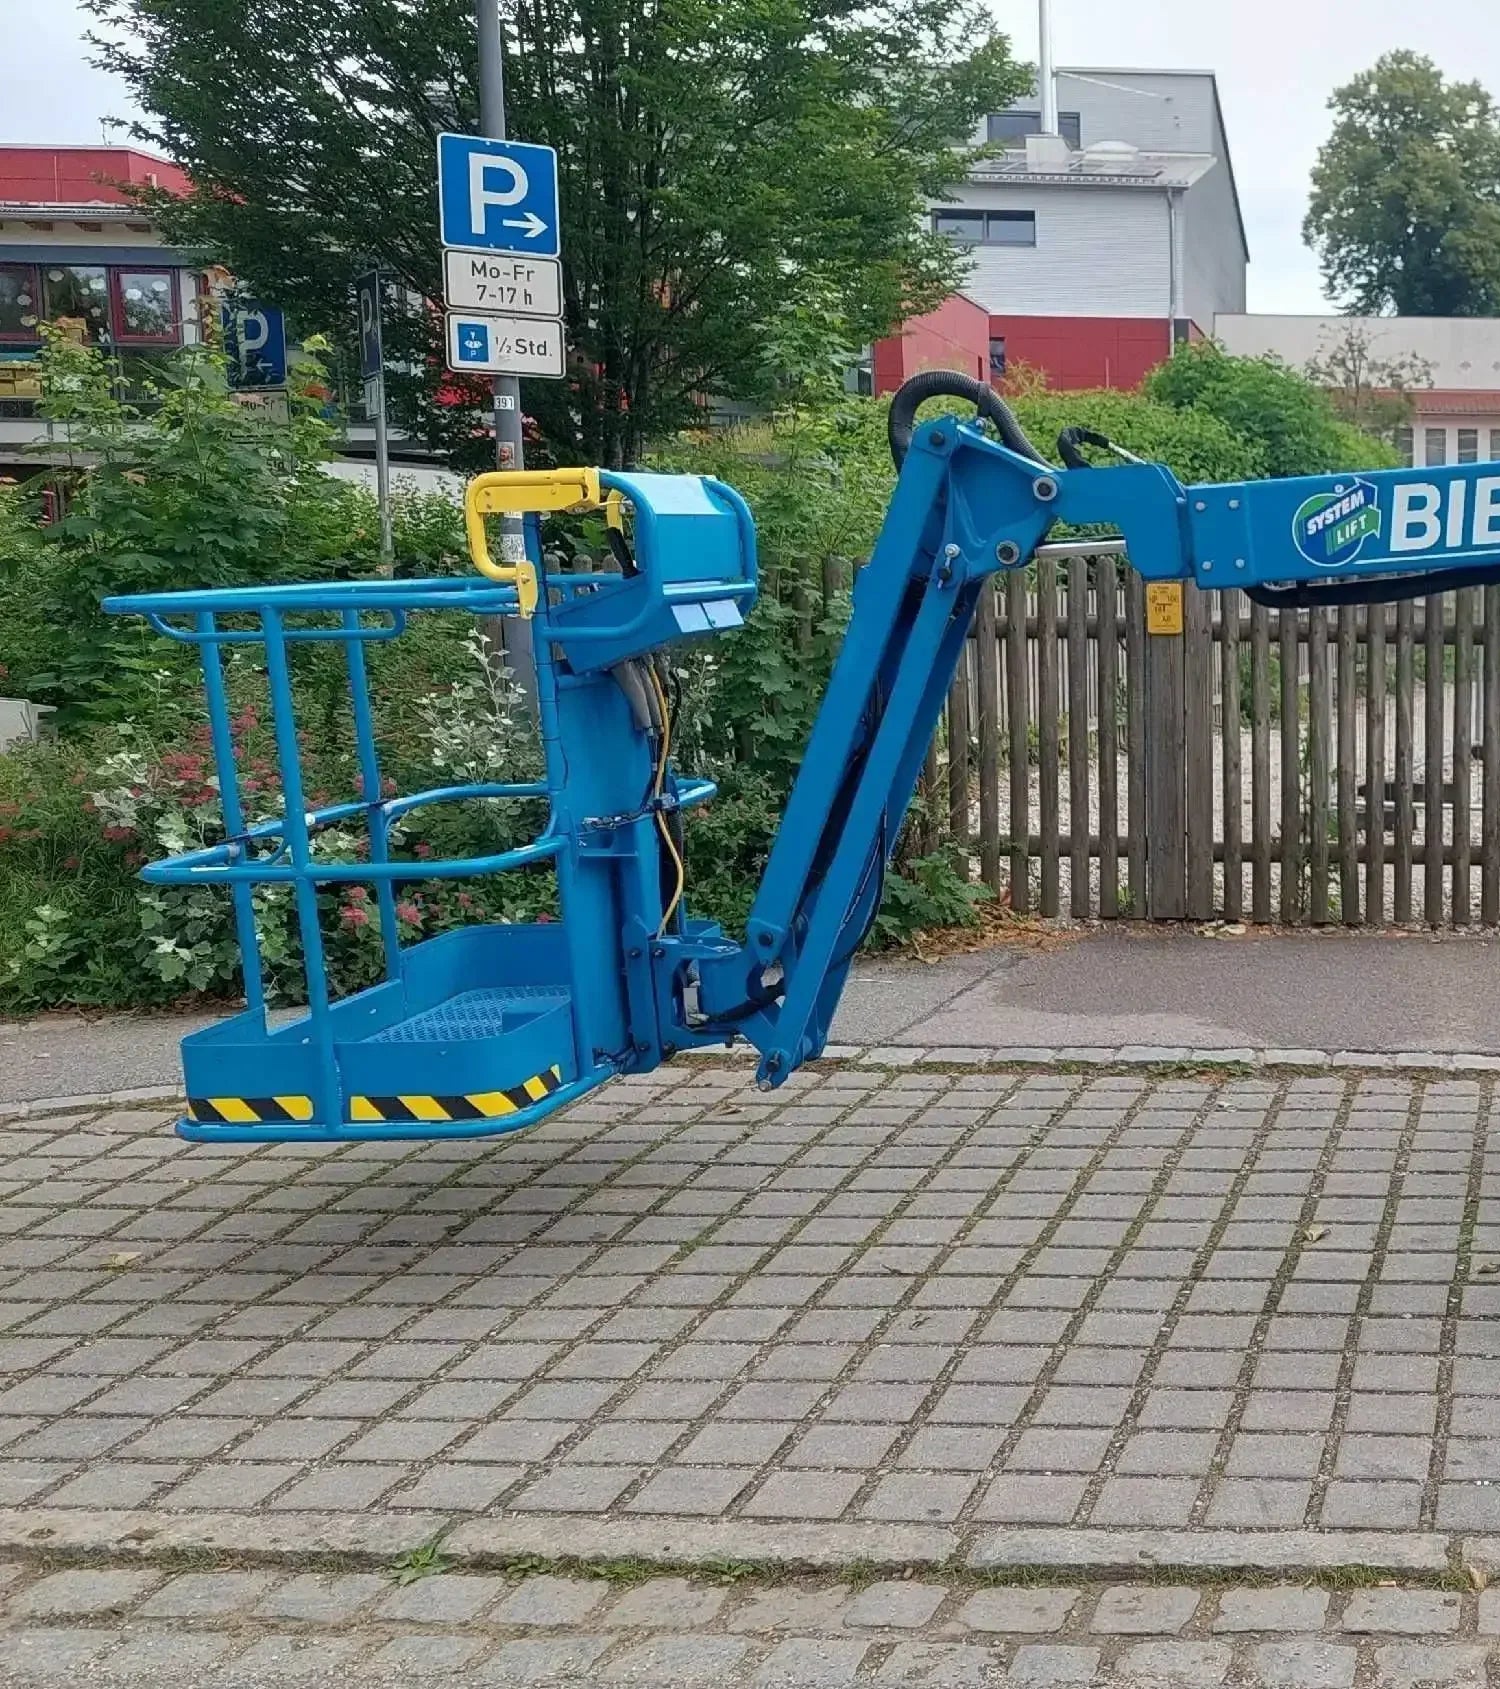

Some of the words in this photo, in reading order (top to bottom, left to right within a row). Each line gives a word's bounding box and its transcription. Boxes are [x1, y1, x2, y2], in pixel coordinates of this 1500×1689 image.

[468, 151, 528, 235] P
[471, 260, 535, 282] Mo-Fr
[476, 284, 517, 305] 7-17
[524, 288, 532, 305] h
[236, 309, 269, 381] P
[515, 338, 553, 357] Std.
[1306, 489, 1365, 535] SYSTEM
[1336, 514, 1367, 545] LIFT
